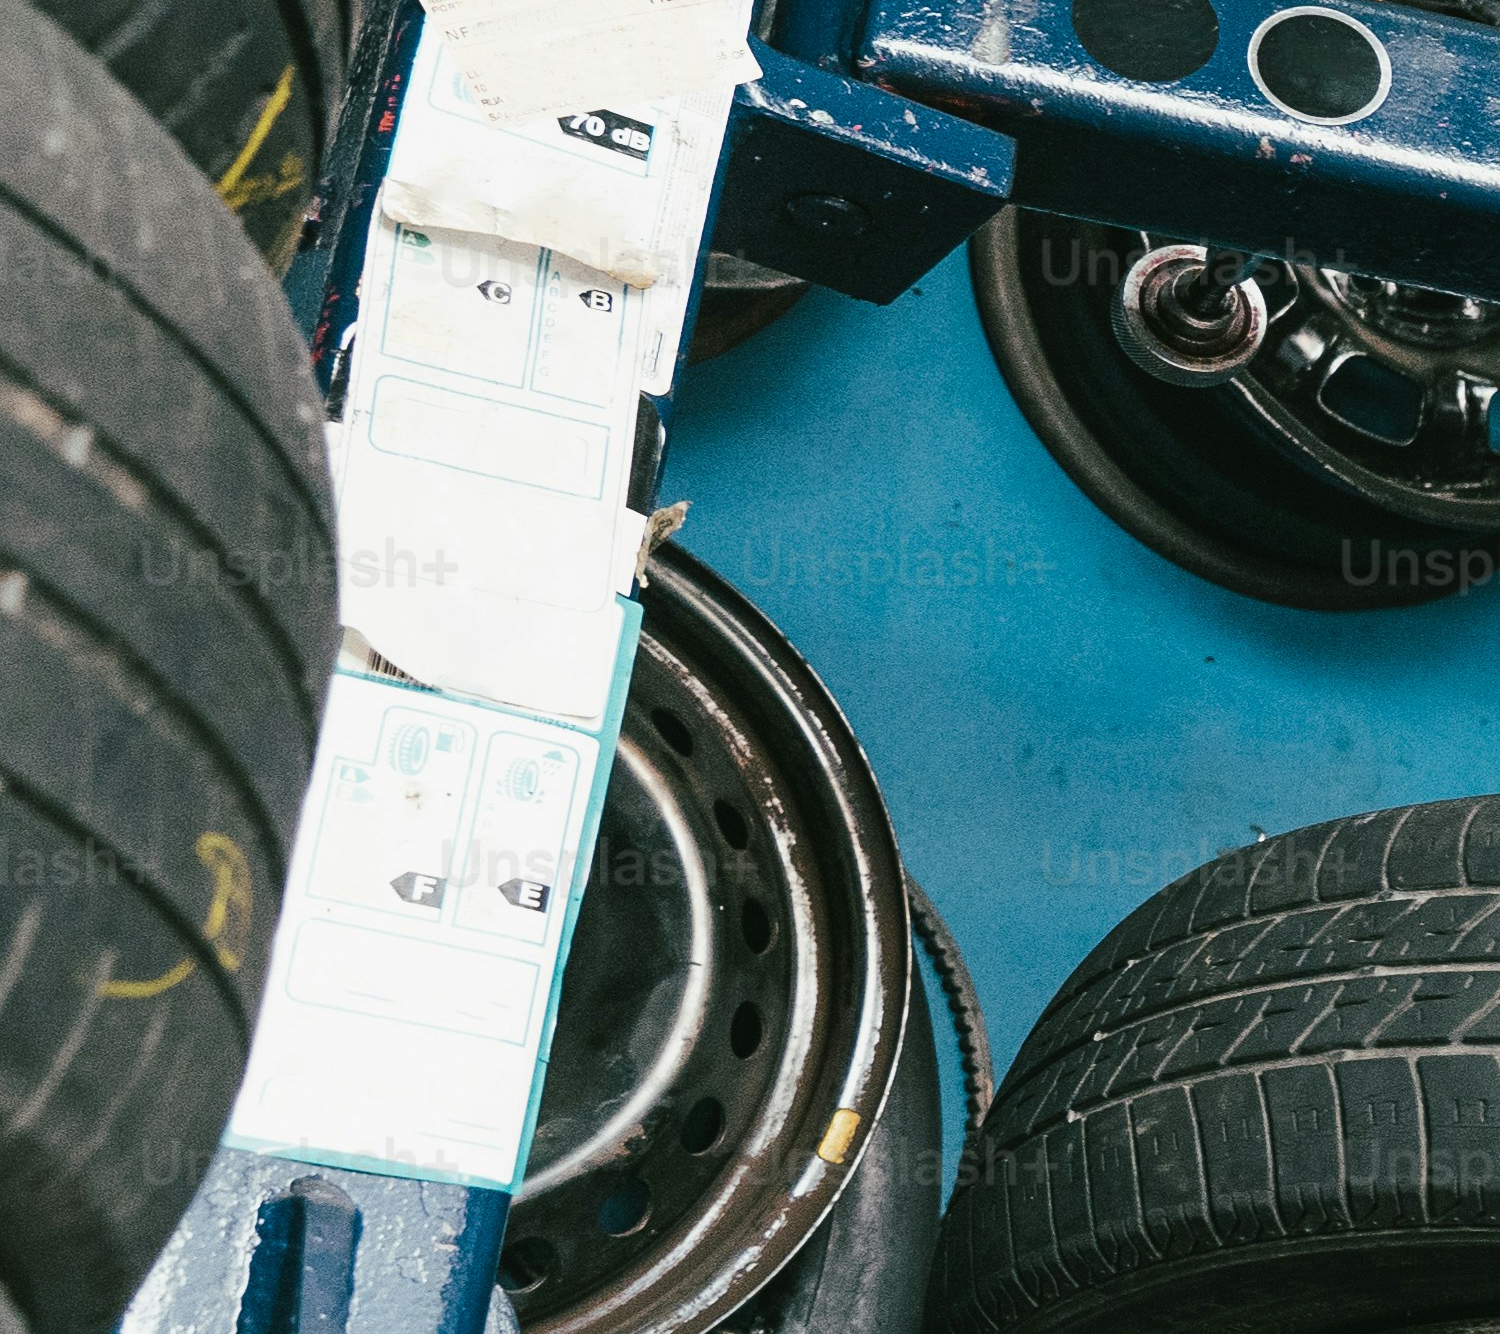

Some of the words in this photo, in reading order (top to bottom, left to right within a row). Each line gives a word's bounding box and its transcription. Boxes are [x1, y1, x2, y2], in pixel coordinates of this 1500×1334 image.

[570, 113, 606, 138] 70
[610, 126, 652, 153] dB
[590, 290, 612, 312] B
[411, 875, 438, 901] F
[518, 880, 544, 908] E
